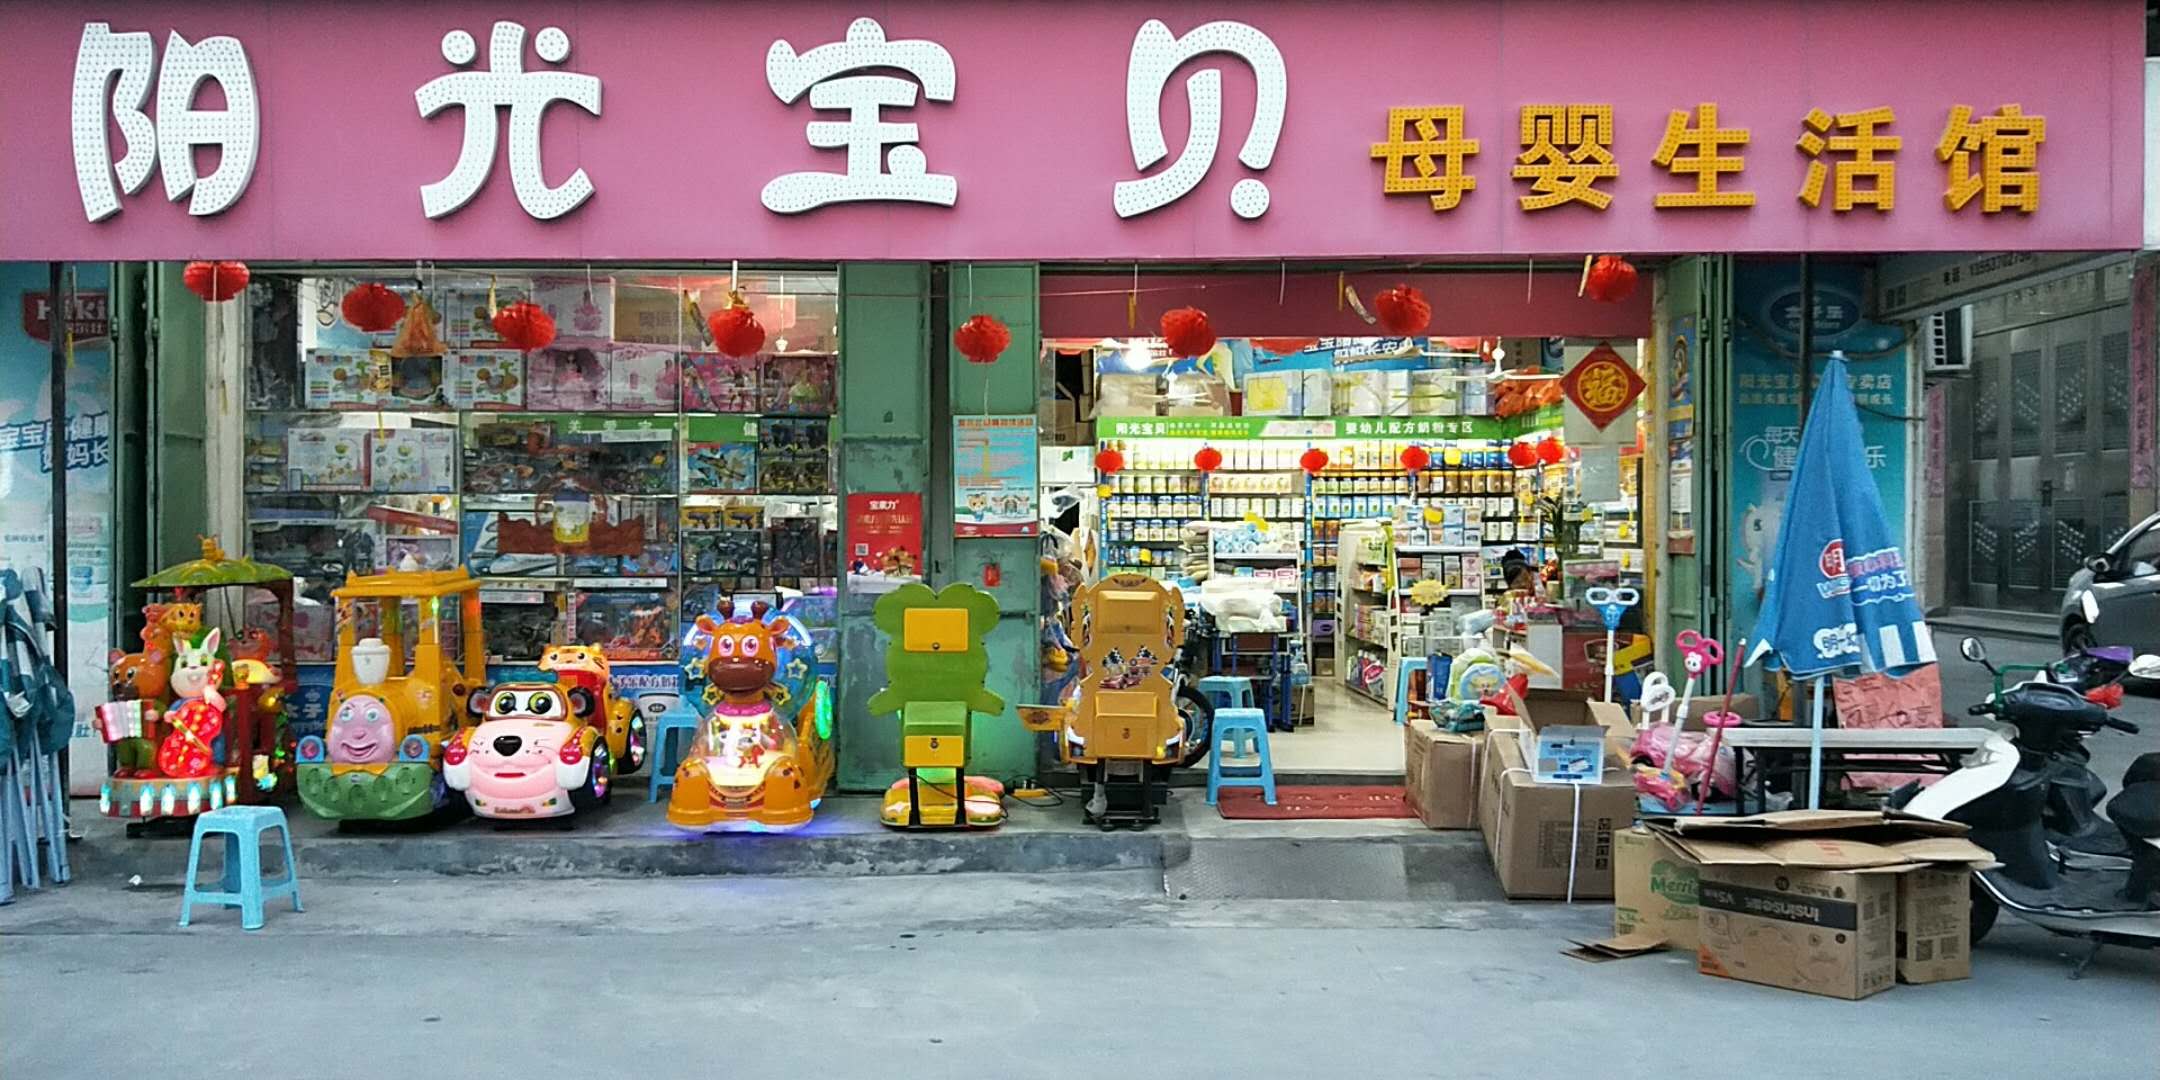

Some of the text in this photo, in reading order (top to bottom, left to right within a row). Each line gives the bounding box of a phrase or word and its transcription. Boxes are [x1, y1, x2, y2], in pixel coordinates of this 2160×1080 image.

[71, 16, 1289, 224] 阳光宝贝
[1369, 102, 2047, 214] 母婴生活馆
[1115, 422, 1166, 435] 阳光宝贝
[1345, 421, 1474, 434] 婴幼儿配方奶粉专区
